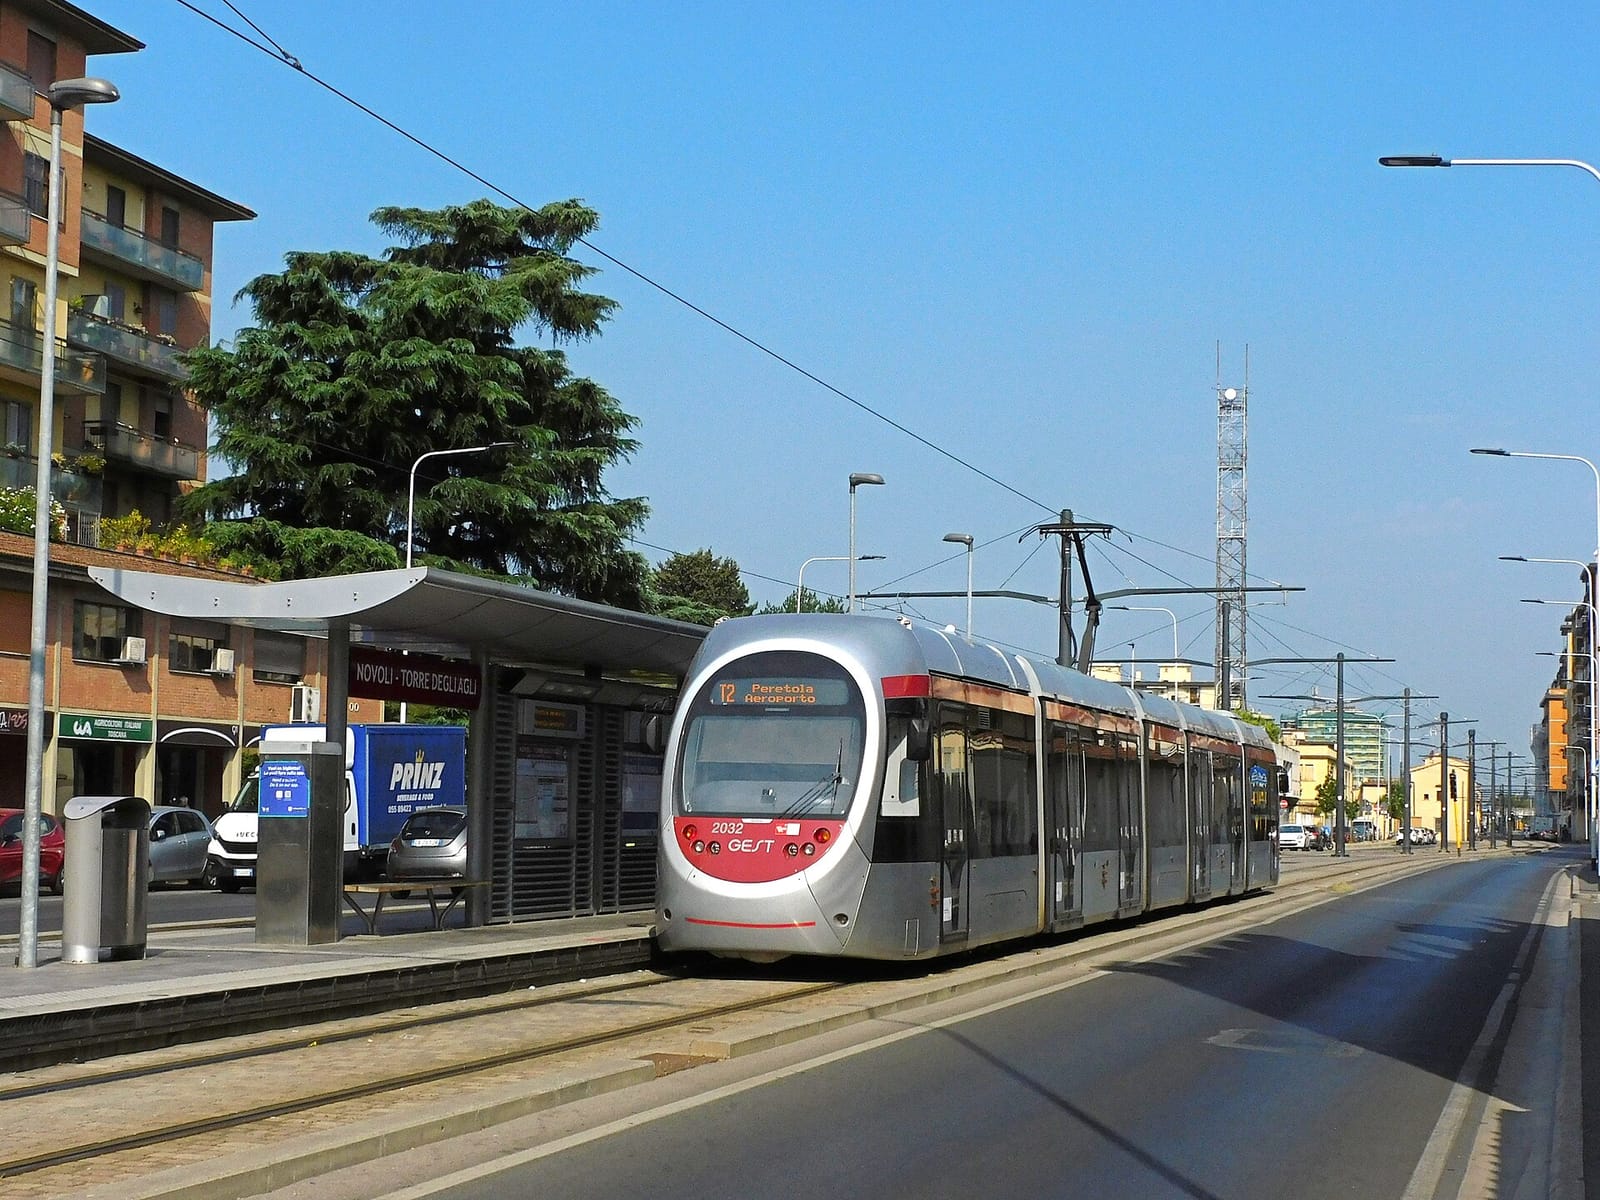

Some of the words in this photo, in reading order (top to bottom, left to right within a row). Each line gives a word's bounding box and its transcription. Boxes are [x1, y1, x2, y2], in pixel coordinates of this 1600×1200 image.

[356, 663, 393, 685] NOVOLI
[400, 669, 430, 689] TORRE
[431, 673, 457, 693] DEGLI
[457, 678, 477, 695] AGLI
[720, 683, 736, 703] T2
[752, 684, 814, 694] Peretola
[745, 693, 816, 704] Aeroporto
[389, 762, 446, 791] PRINZ
[421, 793, 434, 801] FOOD
[711, 822, 744, 835] 2032
[728, 839, 775, 853] GEST
